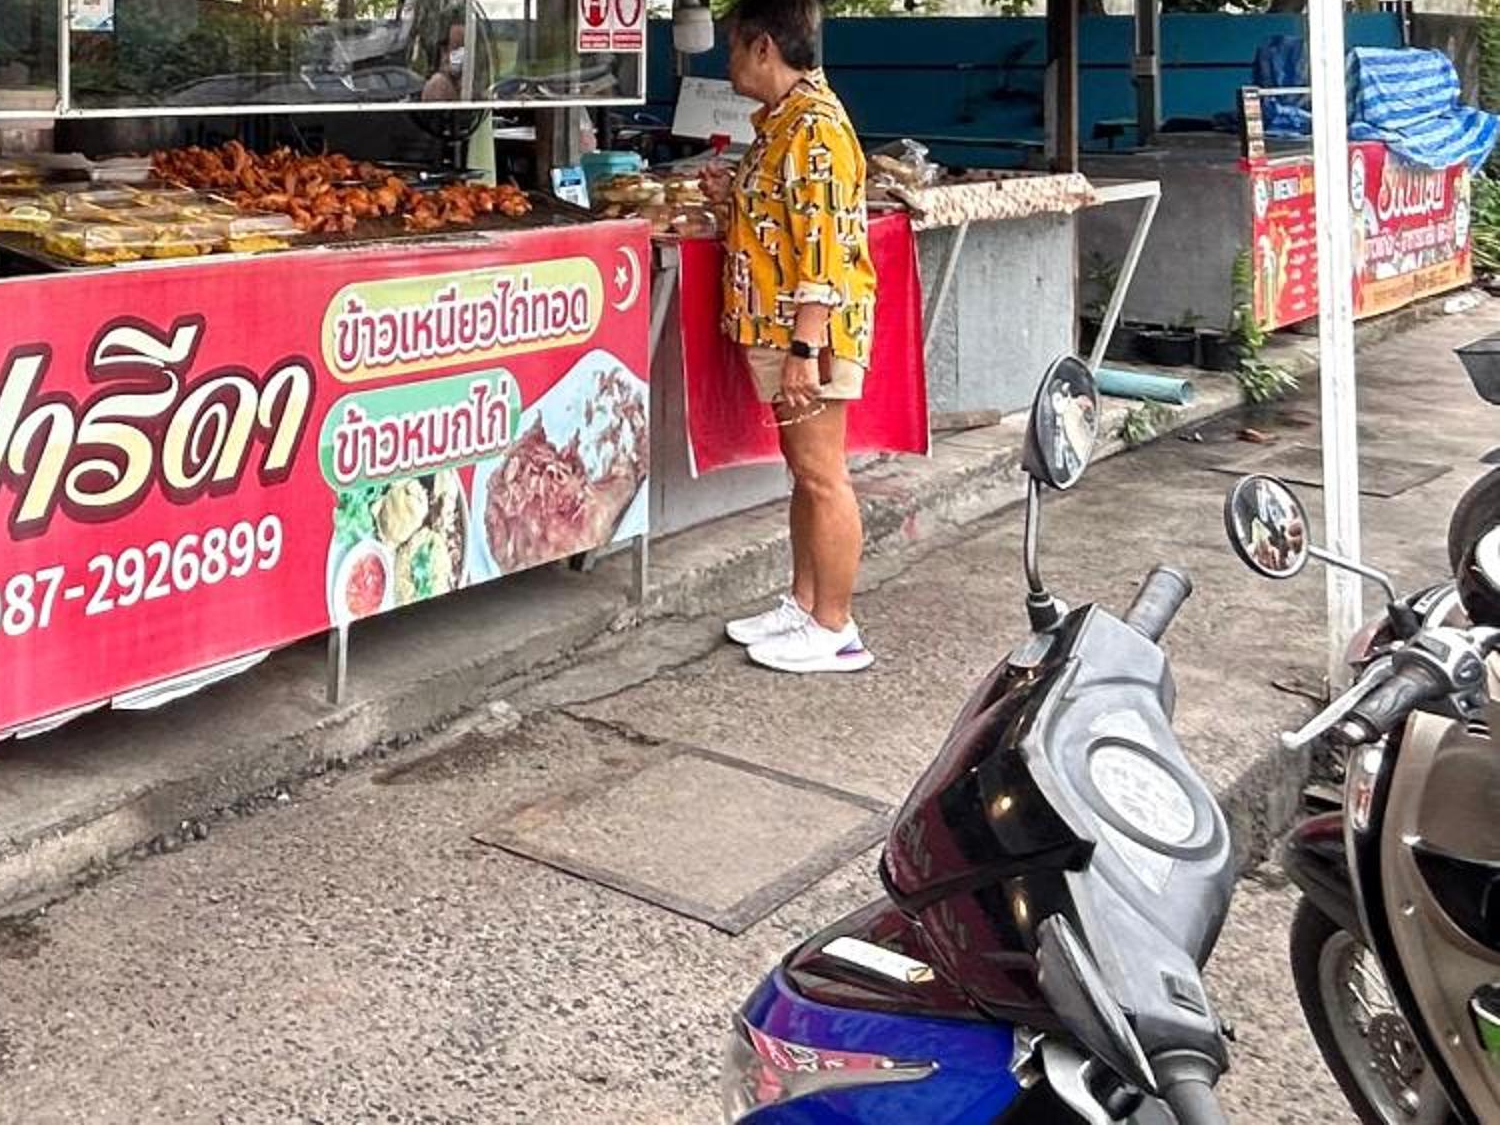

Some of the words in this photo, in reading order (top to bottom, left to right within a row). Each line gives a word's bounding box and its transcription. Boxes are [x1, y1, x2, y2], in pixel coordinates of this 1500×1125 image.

[332, 269, 592, 373] ข้าวเหนียวไก่ทอด
[332, 385, 509, 476] ข้าวหมกไก่
